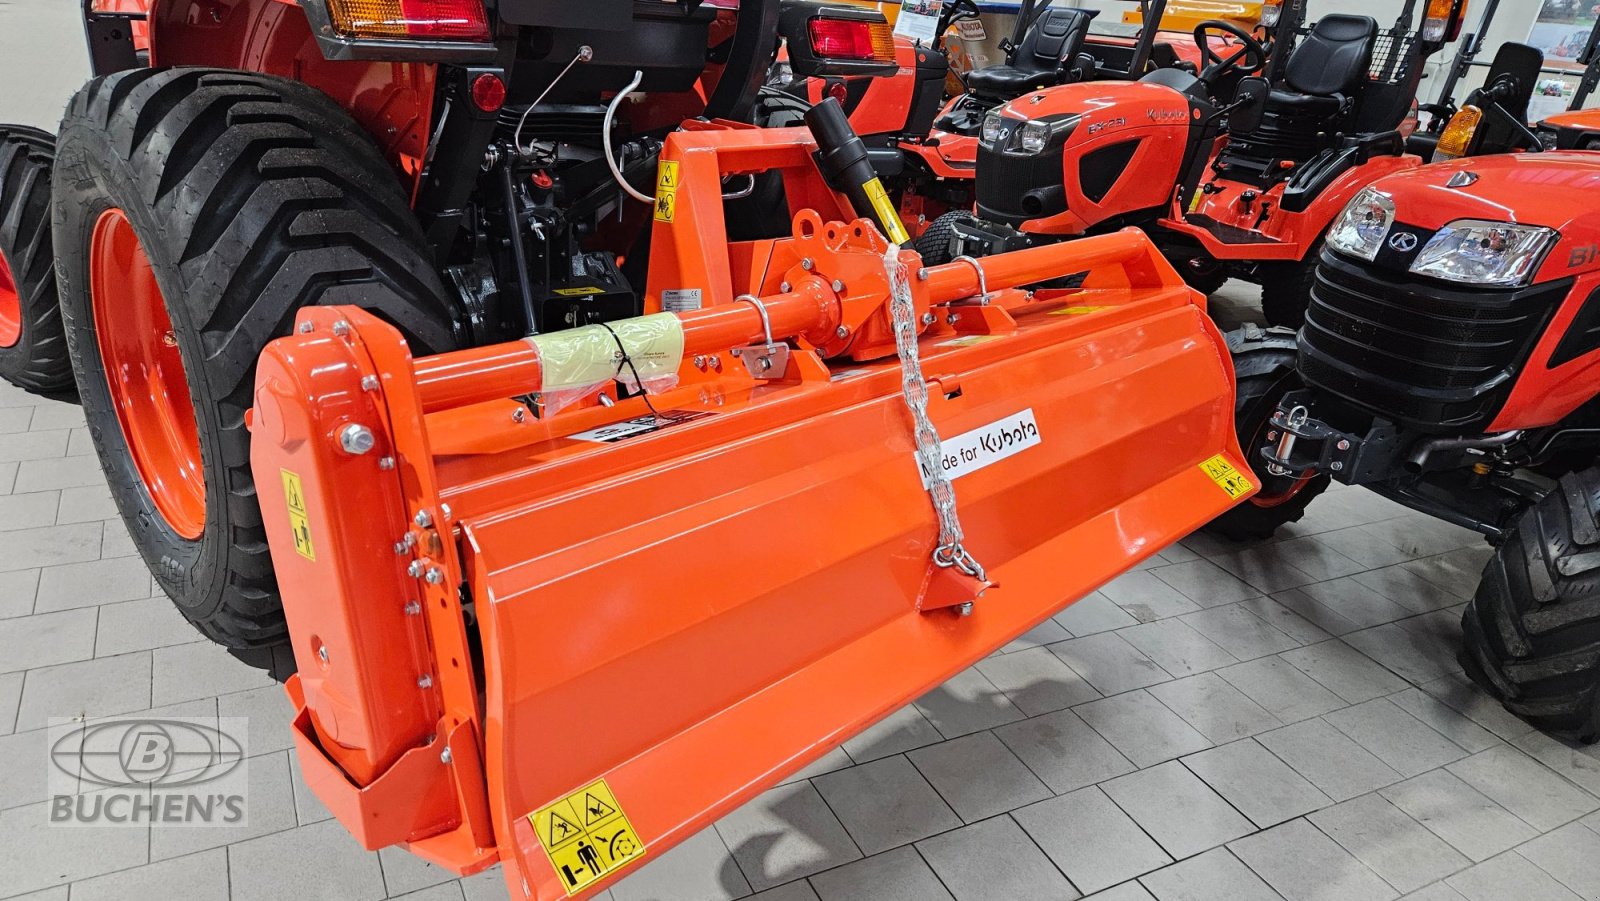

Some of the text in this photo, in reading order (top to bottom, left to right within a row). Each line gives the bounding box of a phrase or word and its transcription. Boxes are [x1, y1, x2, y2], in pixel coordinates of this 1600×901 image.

[921, 420, 1037, 478] Mde for Kubota
